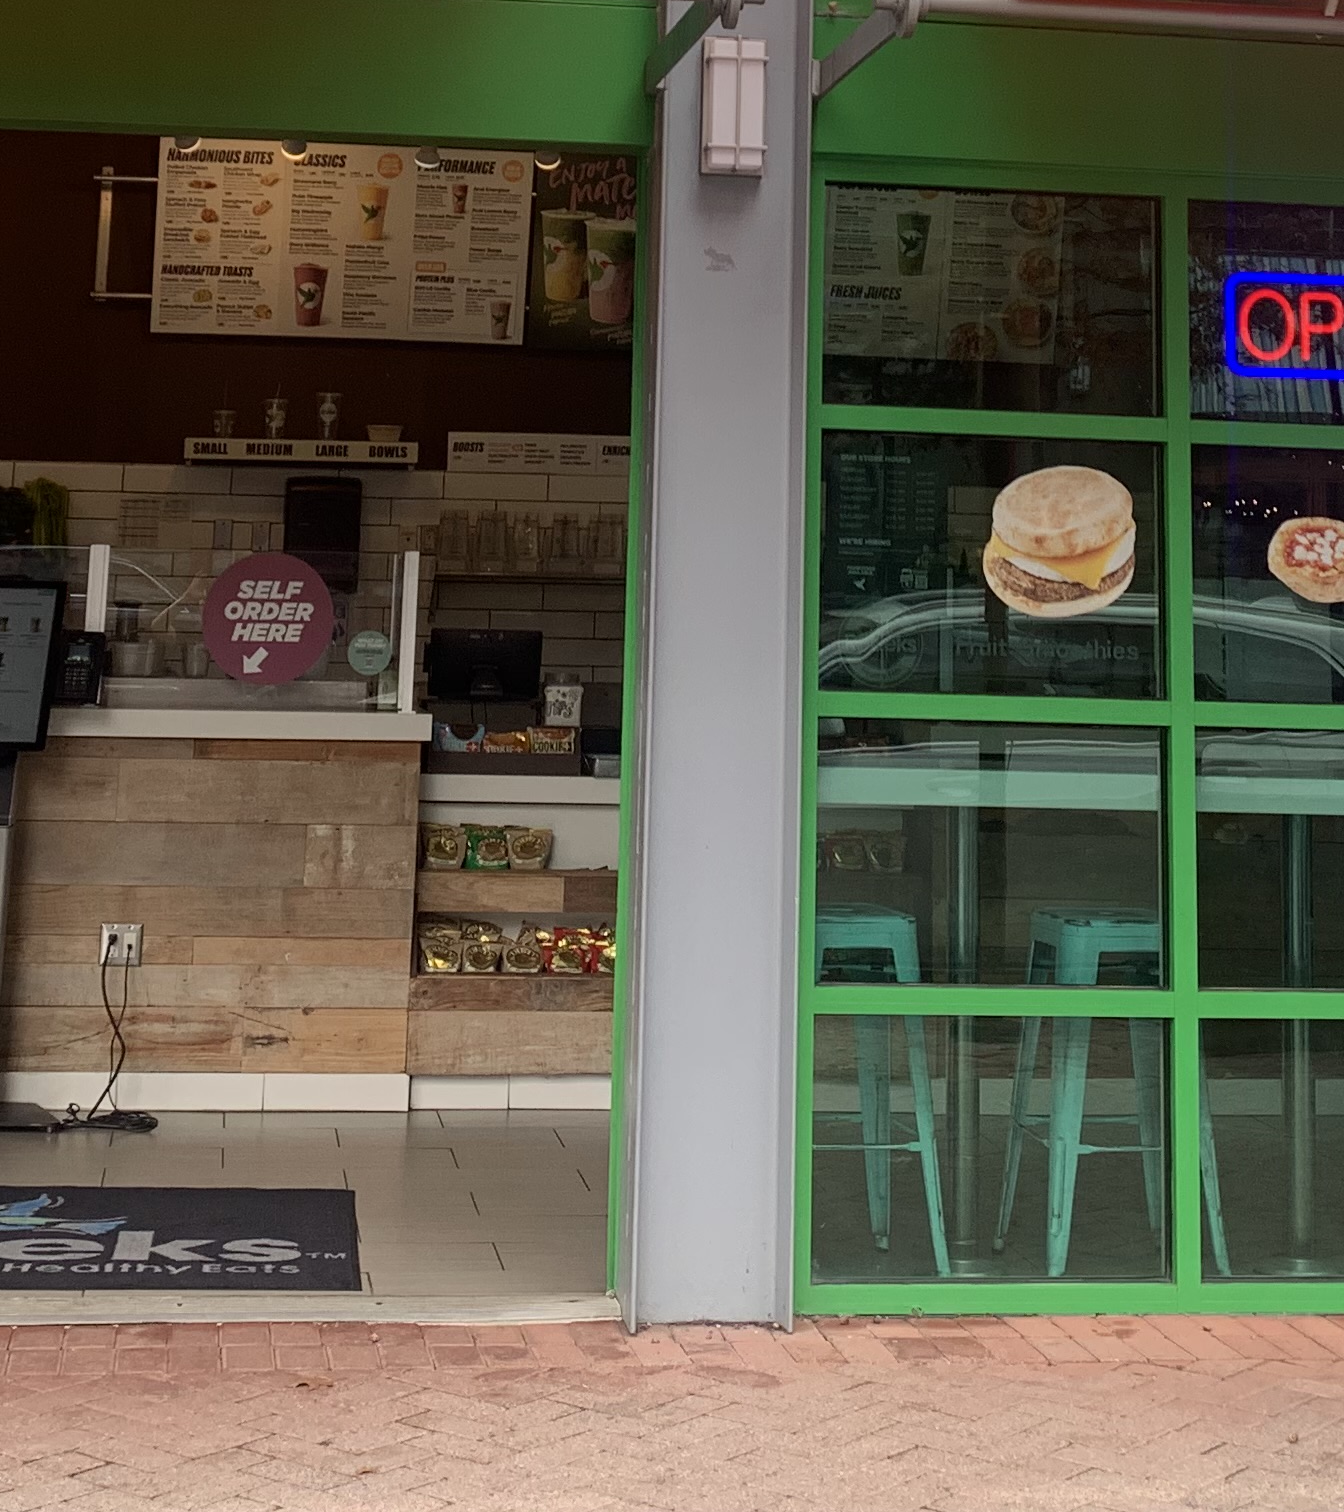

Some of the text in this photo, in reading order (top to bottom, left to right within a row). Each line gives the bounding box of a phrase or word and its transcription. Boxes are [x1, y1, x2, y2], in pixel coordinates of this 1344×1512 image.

[243, 151, 275, 165] BITES
[417, 159, 497, 175] FORMANCE
[549, 159, 610, 188] ENJOY
[161, 264, 254, 277] HANDCRAFTED TOASTS
[830, 284, 902, 301] FRESH JUICES
[193, 442, 408, 458] SMALL MEDIUM LARGE BOWLS
[453, 442, 485, 453] BOOSTS
[237, 580, 305, 600] SELF
[224, 602, 315, 622] ORDER
[230, 623, 305, 643] HERE
[1, 1261, 193, 1275] Healthy
[201, 1262, 301, 1275] Eats
